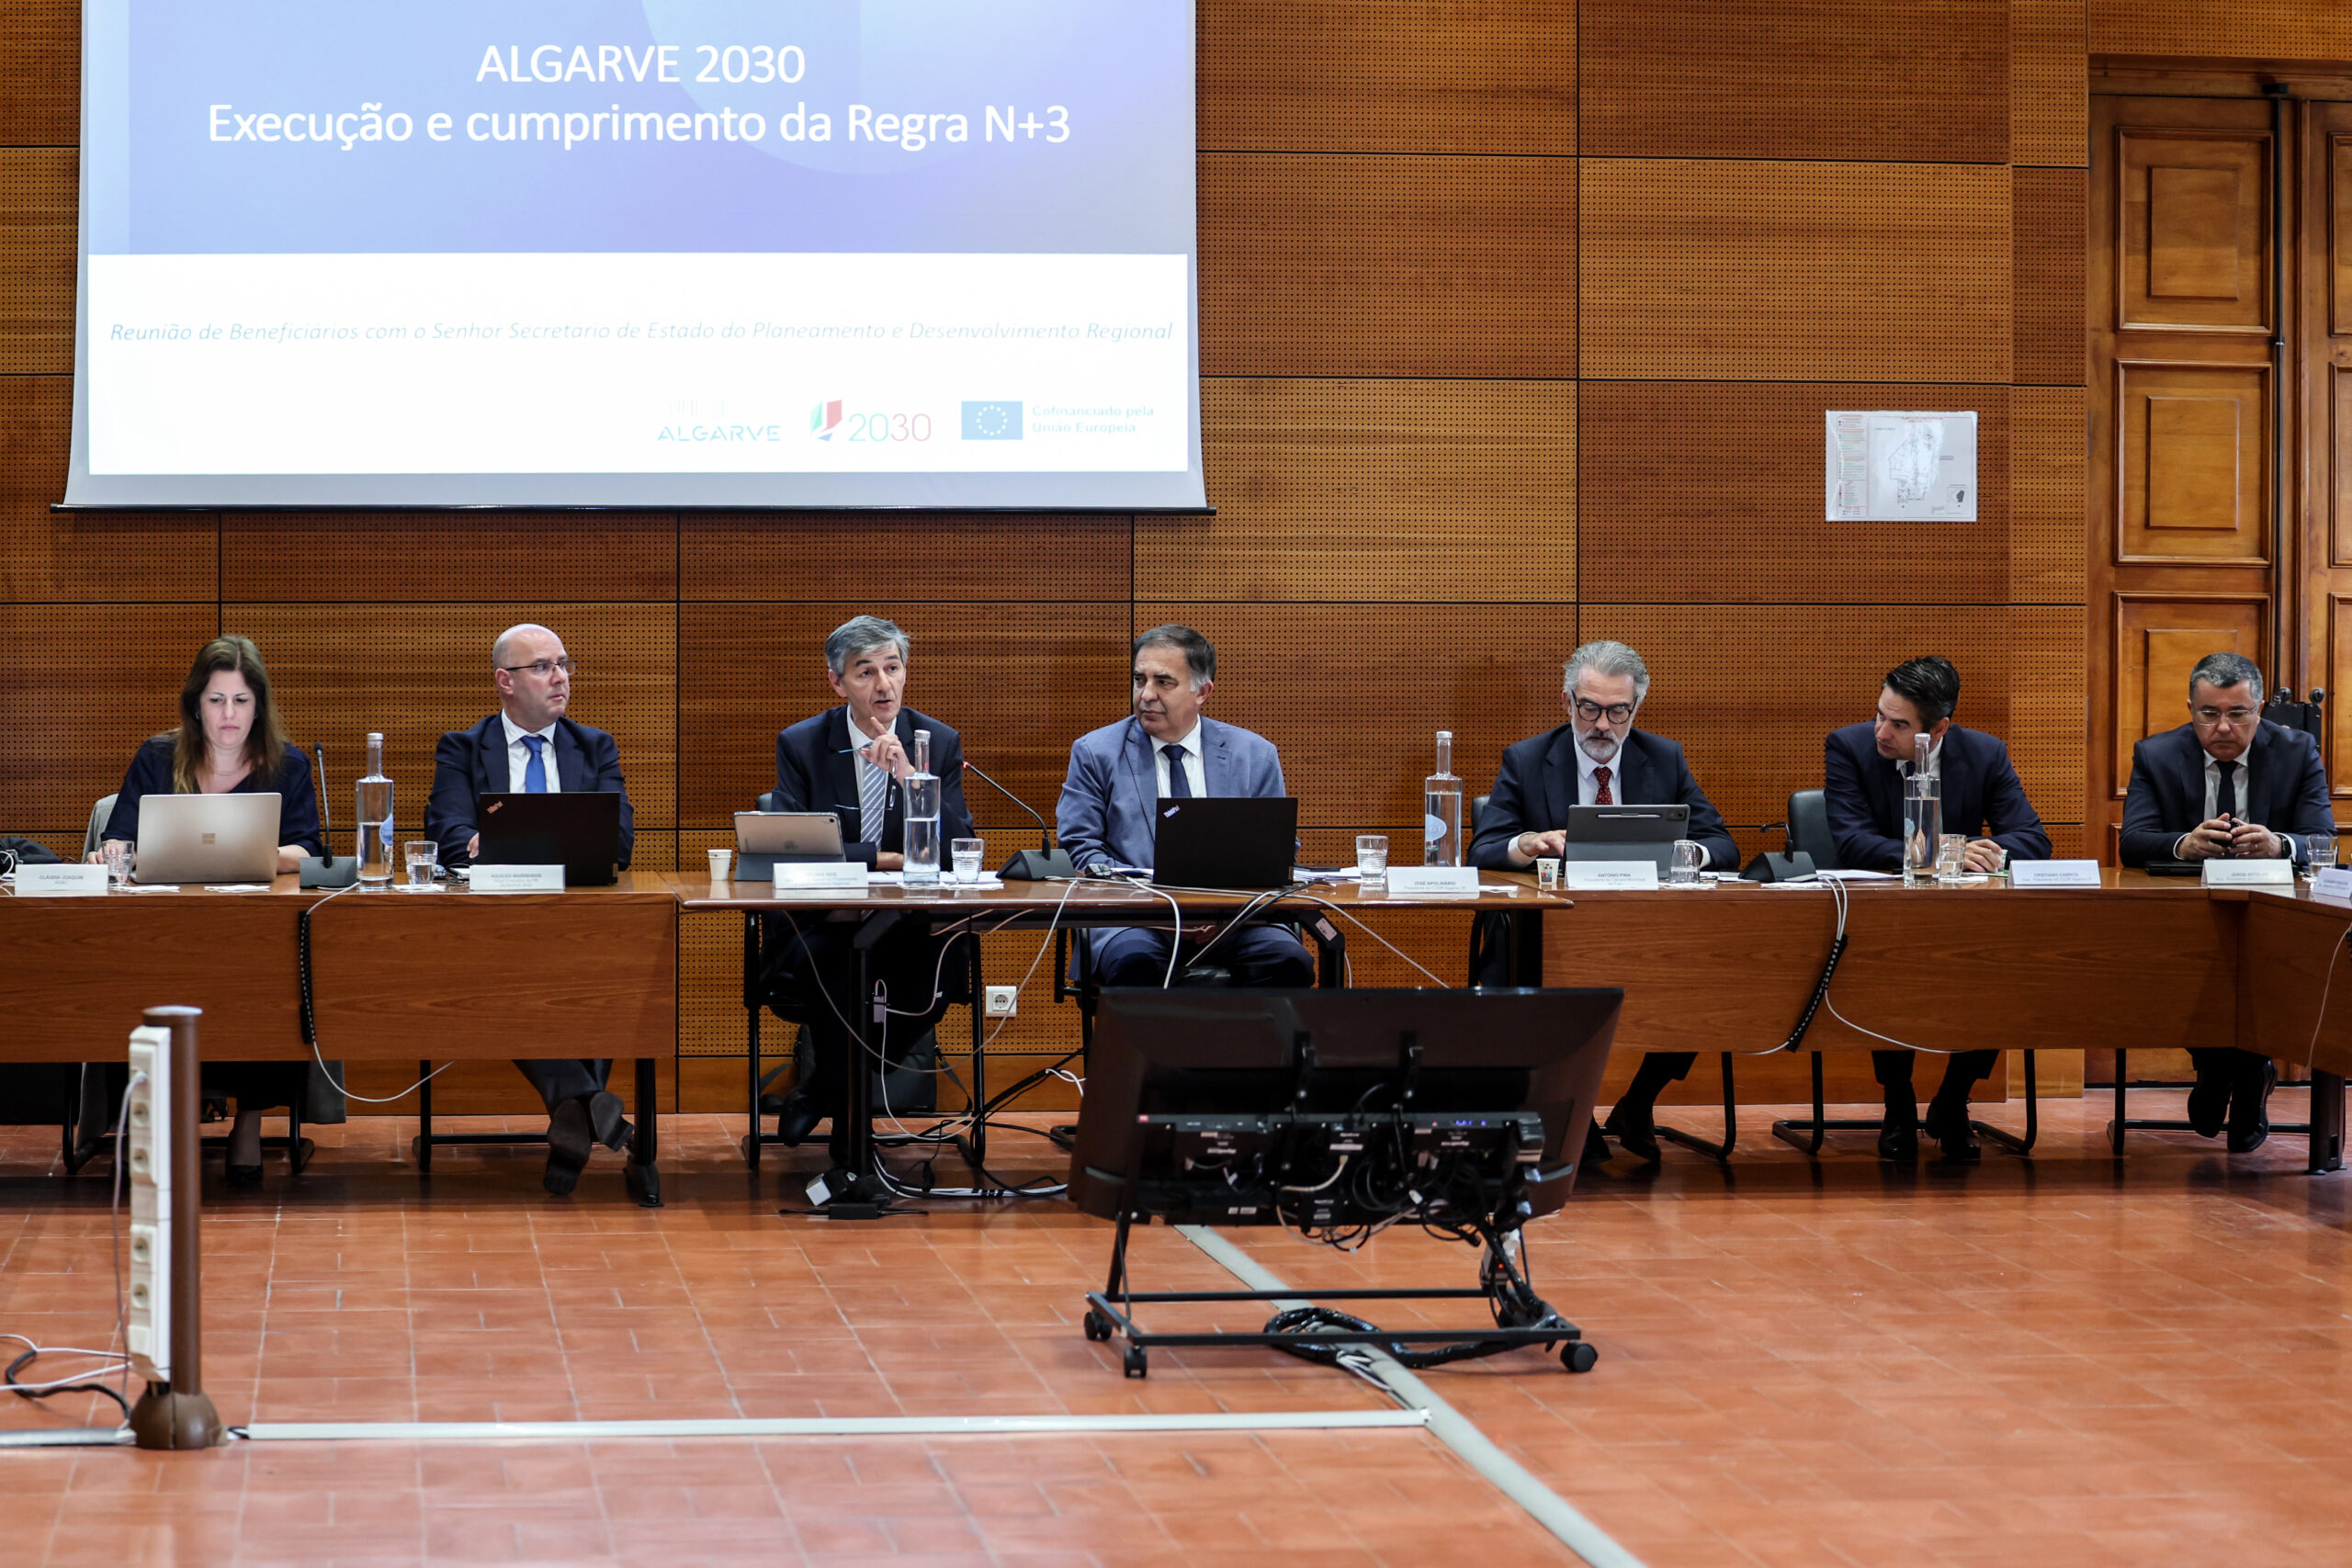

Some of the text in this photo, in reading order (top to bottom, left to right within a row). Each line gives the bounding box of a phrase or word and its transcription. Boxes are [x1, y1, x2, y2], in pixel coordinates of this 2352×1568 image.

[477, 45, 806, 84] ALGARVE 2030
[209, 102, 1070, 151] Execução e cumprimento da Regra N+3
[110, 321, 1173, 344] Reunião de Beneficiários com o Senhor Secretário de Estado do Planeamento e Desenvolvimento Regional
[1032, 404, 1155, 419] Cofinanciado pela
[656, 424, 782, 443] ALGARVE
[847, 412, 932, 443] 2030
[1076, 422, 1136, 434] Europeia
